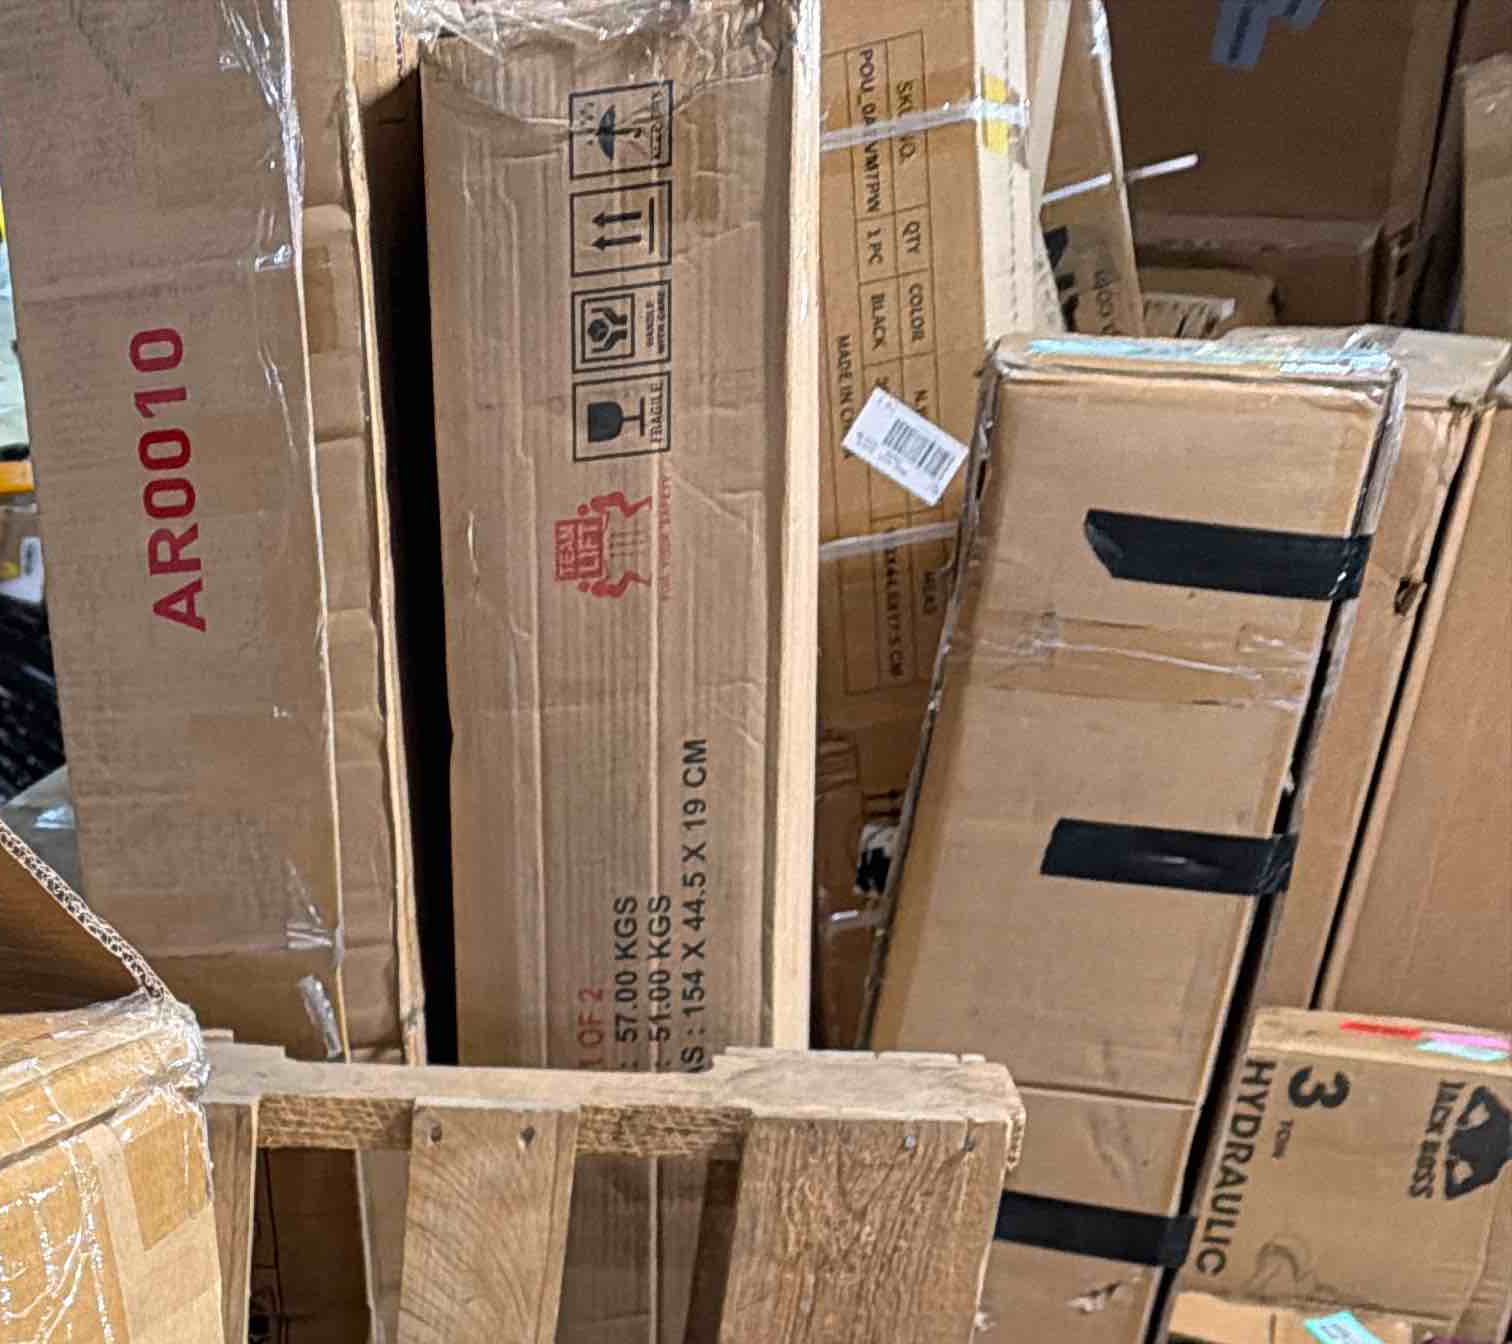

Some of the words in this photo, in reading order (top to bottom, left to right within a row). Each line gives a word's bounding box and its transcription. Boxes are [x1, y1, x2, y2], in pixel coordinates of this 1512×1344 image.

[868, 242, 883, 265] PC
[902, 221, 920, 253] QTY
[871, 293, 888, 350] BLACK
[908, 283, 925, 342] COLOR
[838, 334, 852, 380] MADE
[650, 383, 664, 444] FRAGILE
[839, 382, 854, 404] IN
[129, 328, 206, 632] AR0010
[558, 522, 575, 577] TEAM
[577, 522, 599, 577] LIFT
[683, 739, 706, 788] CM
[683, 799, 706, 829] 19
[682, 841, 706, 863] X
[614, 896, 638, 961] KGS
[648, 895, 672, 960] KGS
[682, 872, 706, 931] 44.5
[682, 942, 706, 961] X
[578, 987, 603, 1001] 2
[615, 971, 638, 1043] 57.00
[648, 970, 672, 1042] 51.00
[682, 969, 706, 1017] 154
[578, 1014, 604, 1049] OF
[1289, 1066, 1350, 1109] 3
[1426, 1080, 1466, 1134] JACK
[1196, 1058, 1276, 1276] HYDRAULIC
[1408, 1140, 1441, 1199] BOSS
